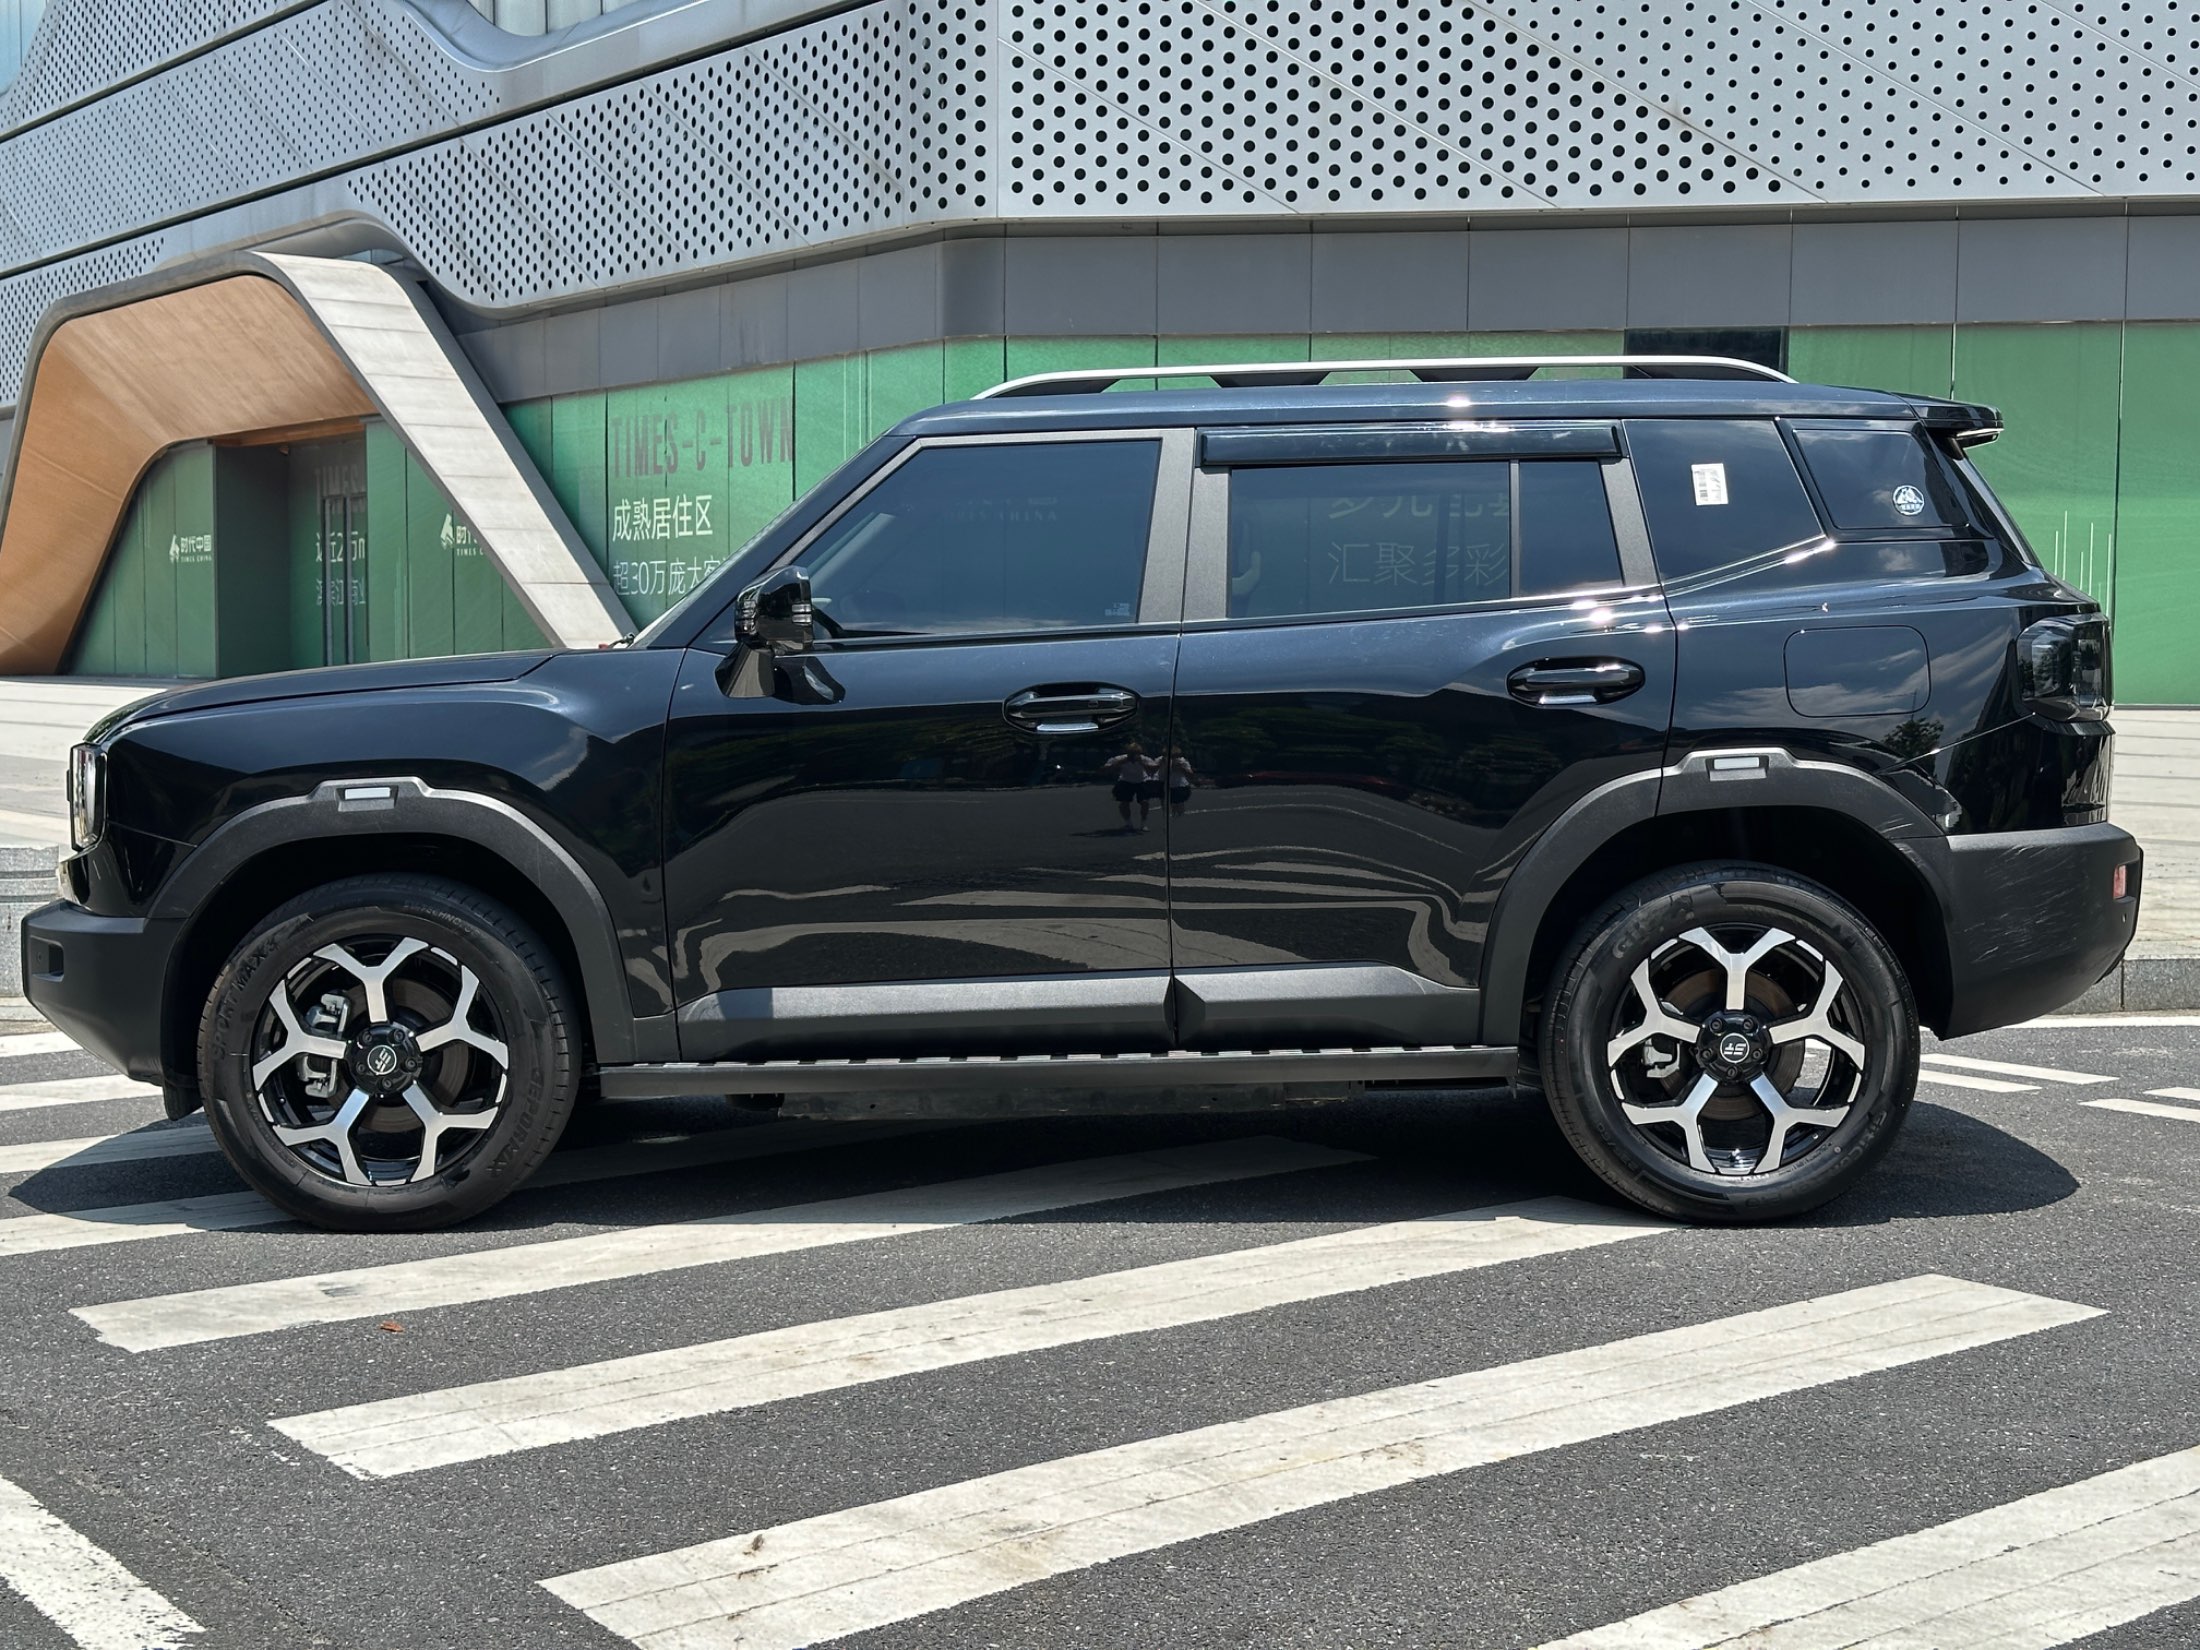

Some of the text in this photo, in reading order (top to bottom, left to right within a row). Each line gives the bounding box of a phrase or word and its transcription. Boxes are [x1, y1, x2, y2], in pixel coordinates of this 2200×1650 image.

[611, 397, 793, 478] TIMES-C-TOWN
[612, 494, 714, 542] 成熟居住区
[612, 554, 727, 596] 超30万庞大客
[1327, 541, 1508, 587] 汇聚多彩
